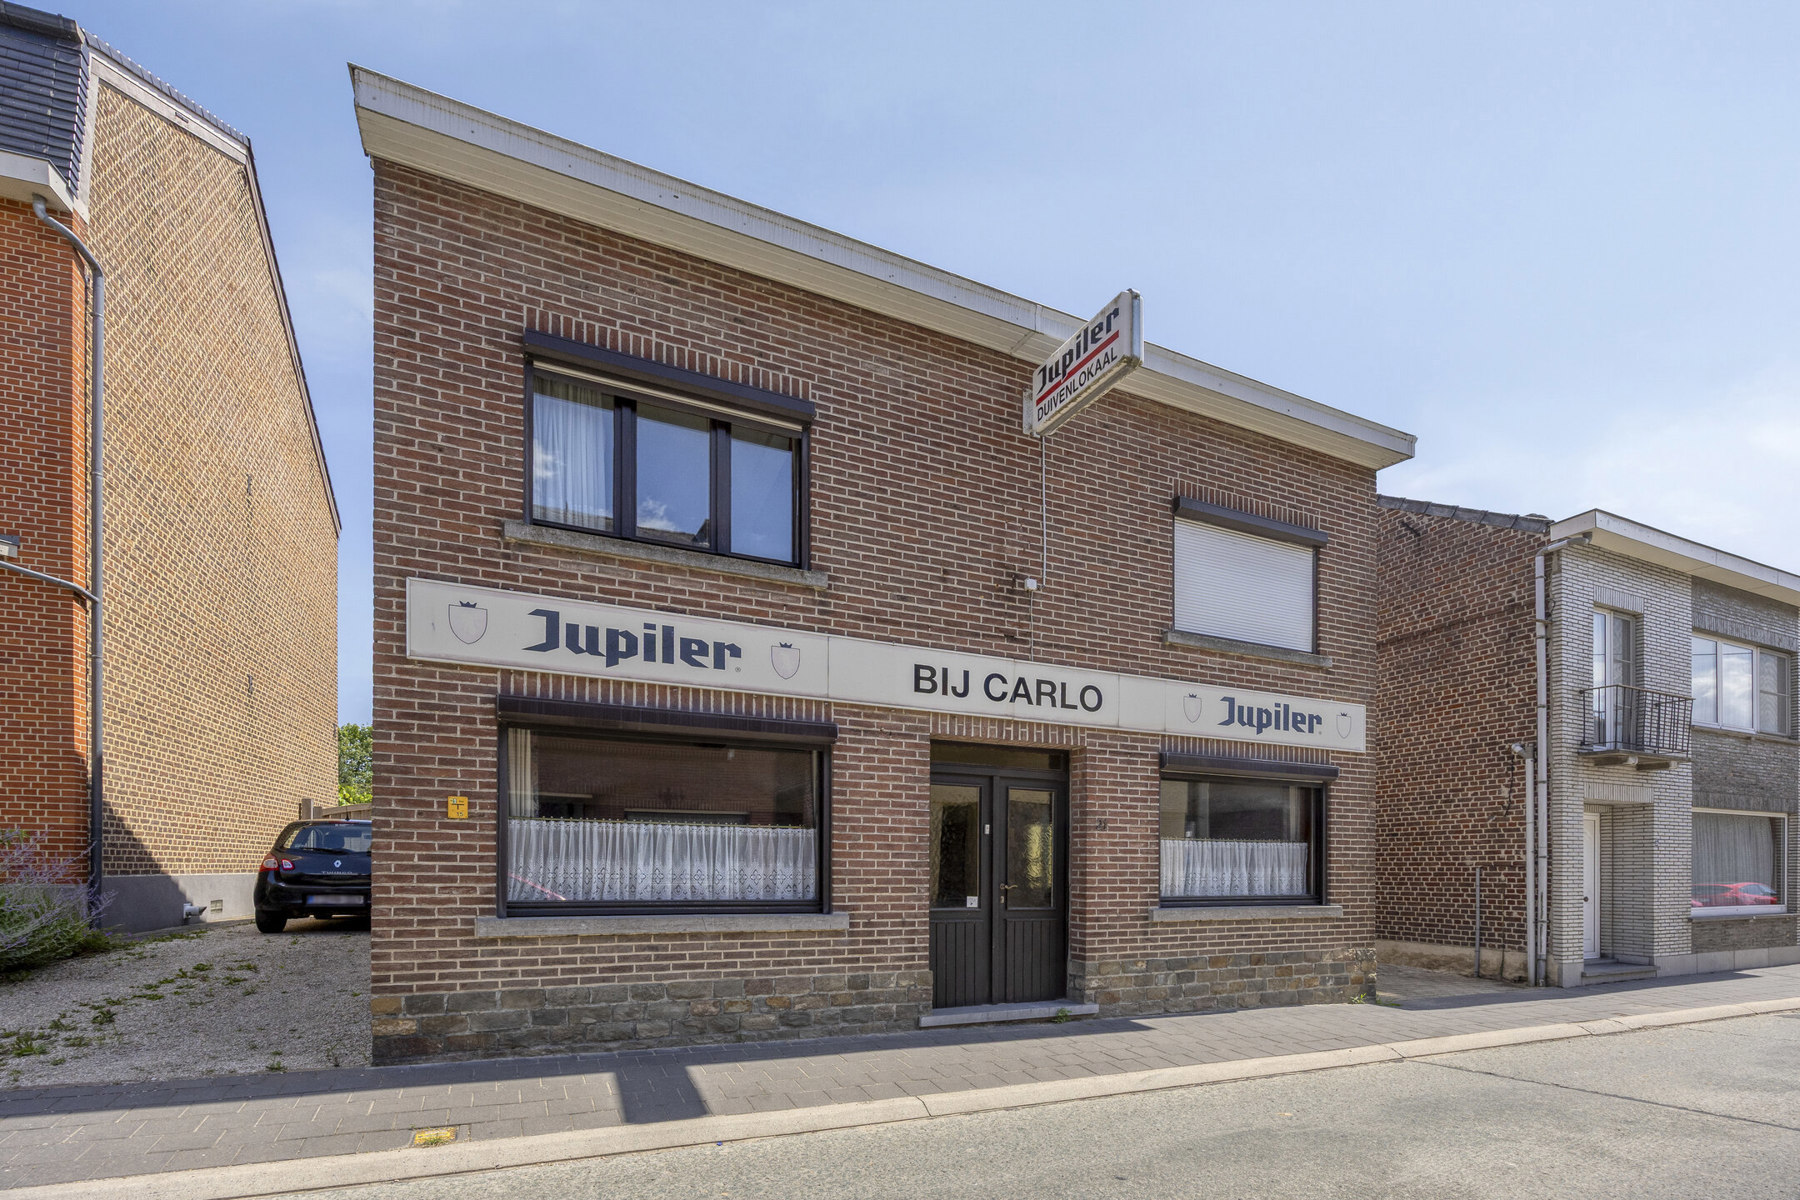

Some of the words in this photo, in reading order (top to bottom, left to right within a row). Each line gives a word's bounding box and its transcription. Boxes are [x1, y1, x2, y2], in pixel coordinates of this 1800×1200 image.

[1036, 307, 1120, 395] Jupiler
[1037, 347, 1118, 422] DUIVENLOKAAL
[521, 608, 742, 671] Jupiler
[913, 663, 970, 698] BIJ
[983, 672, 1103, 713] CARLO
[1217, 696, 1323, 735] Jupiler
